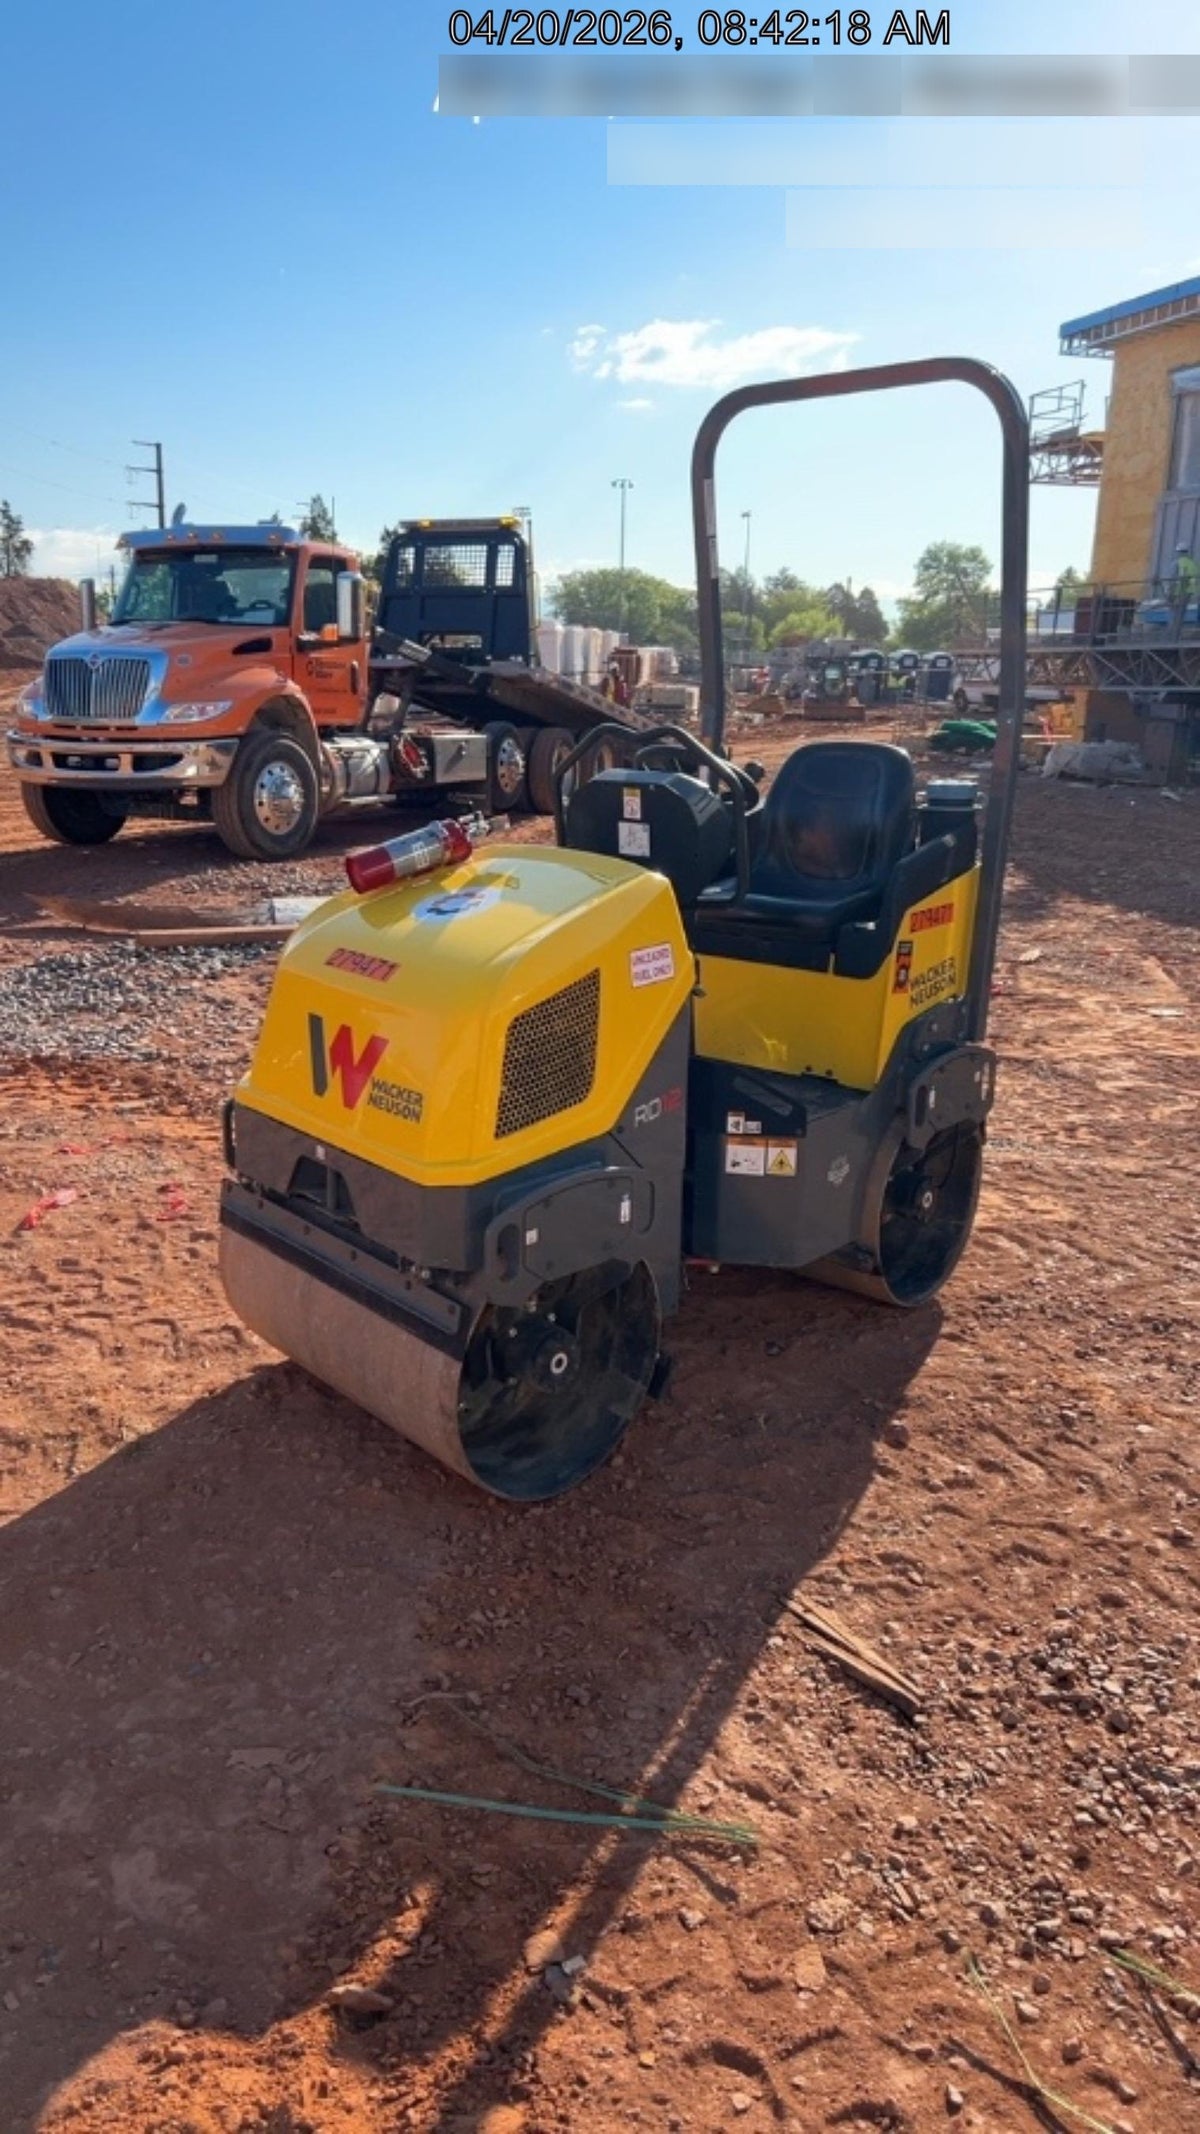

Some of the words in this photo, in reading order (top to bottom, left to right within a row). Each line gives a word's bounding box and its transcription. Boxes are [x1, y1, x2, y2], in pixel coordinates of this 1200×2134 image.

[325, 947, 400, 982] 279471
[371, 1077, 423, 1107] WACKER
[368, 1093, 422, 1123] NEUSON
